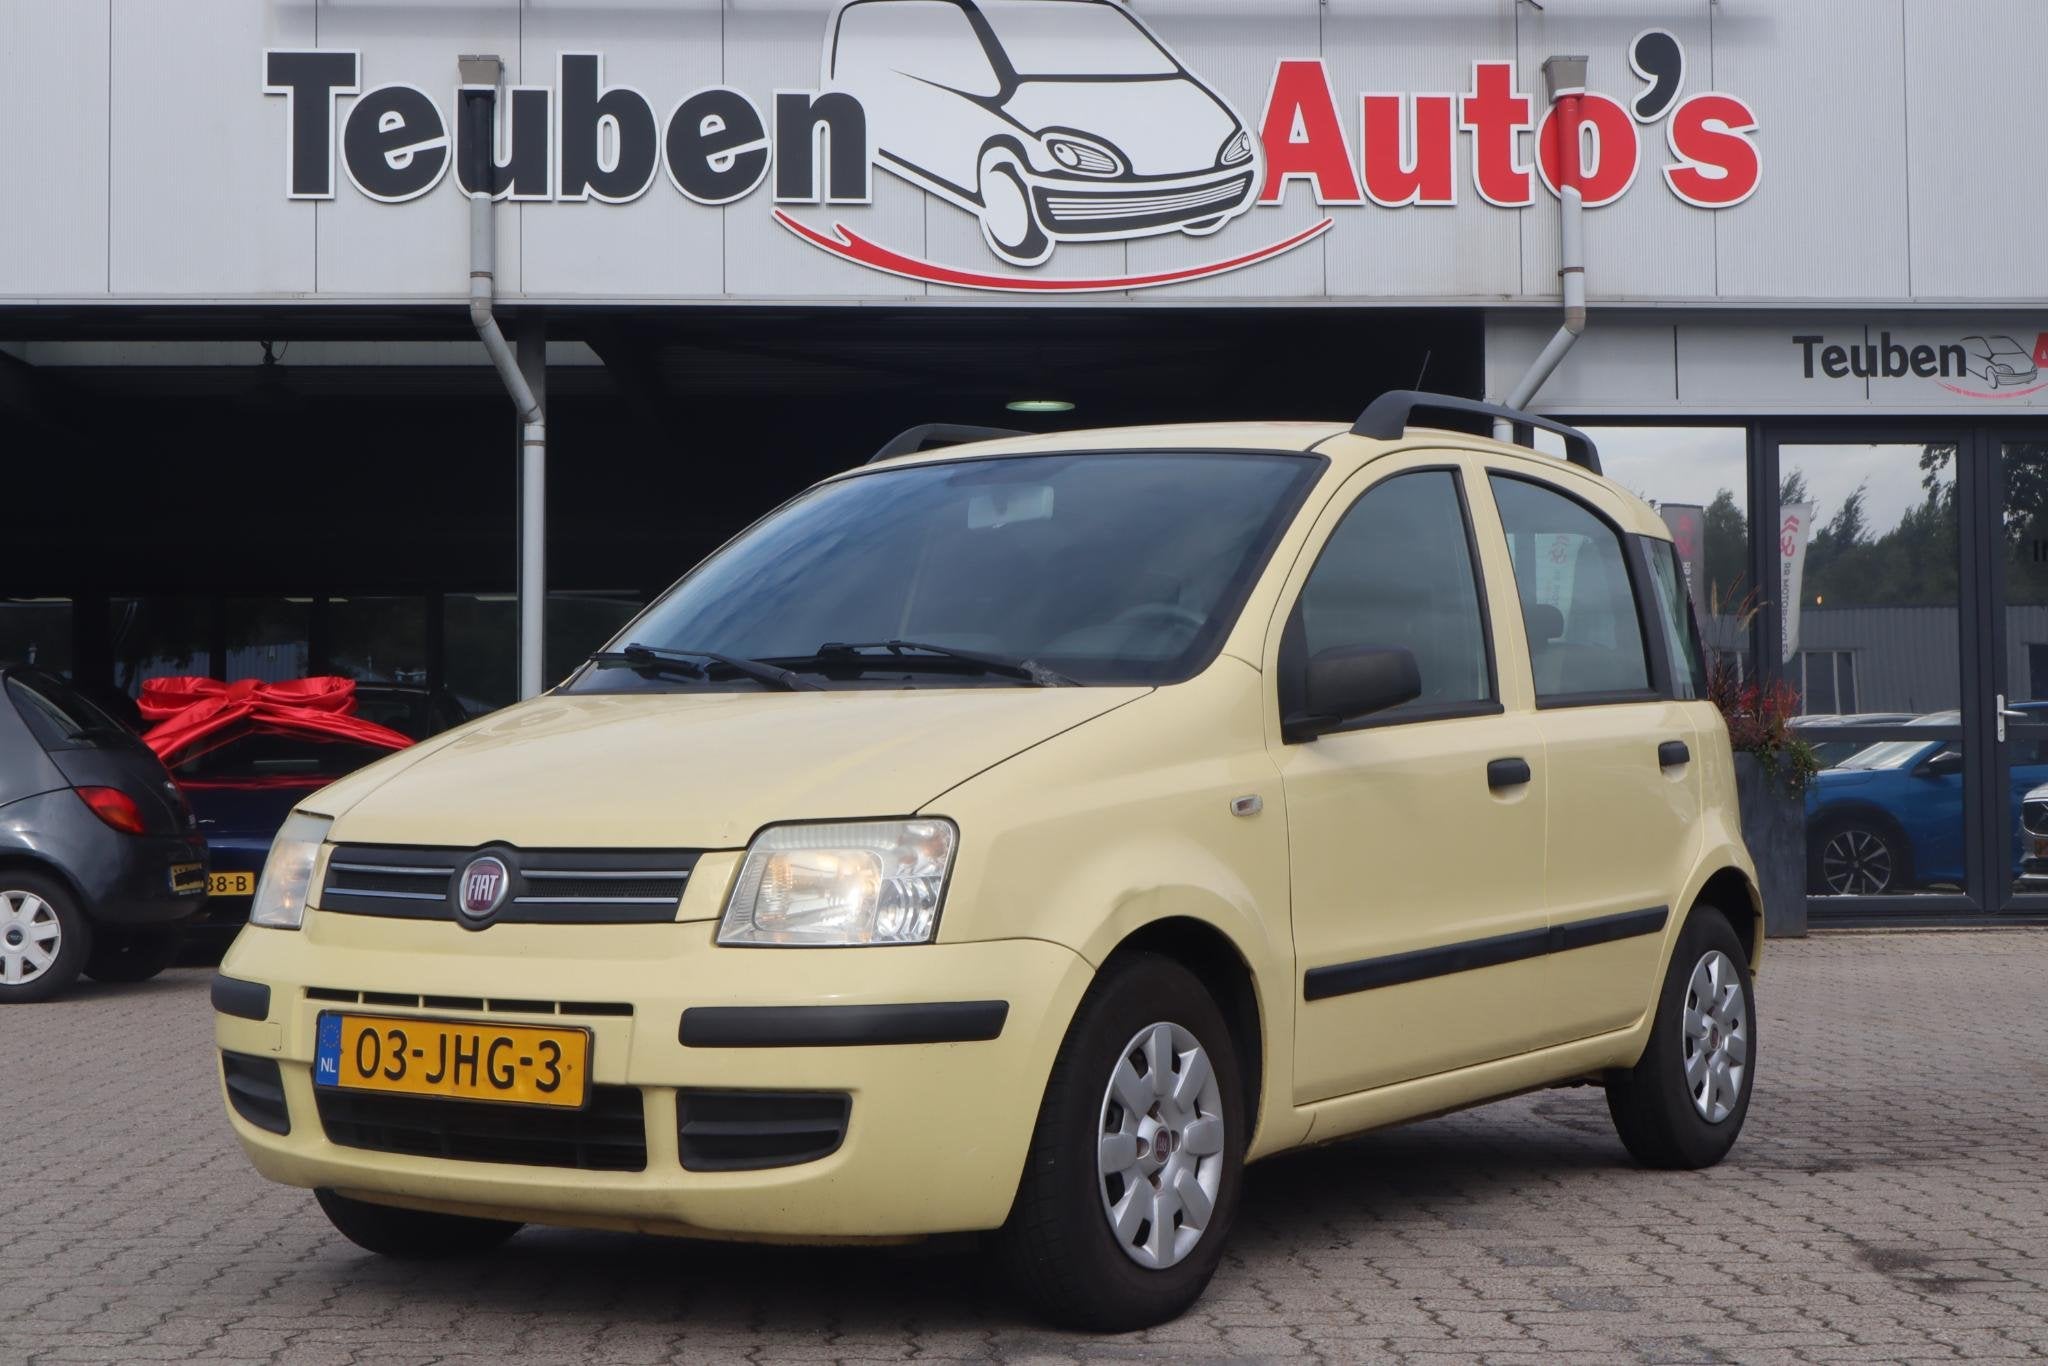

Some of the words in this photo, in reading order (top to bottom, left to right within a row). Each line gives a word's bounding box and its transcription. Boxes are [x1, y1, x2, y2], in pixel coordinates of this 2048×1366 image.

[265, 50, 869, 202] Teuben
[1261, 30, 1761, 207] Auto's
[1792, 332, 1967, 378] Teuben
[467, 874, 499, 901] FIAT
[320, 1057, 336, 1073] NL
[356, 1027, 561, 1093] 03-JHG-3
